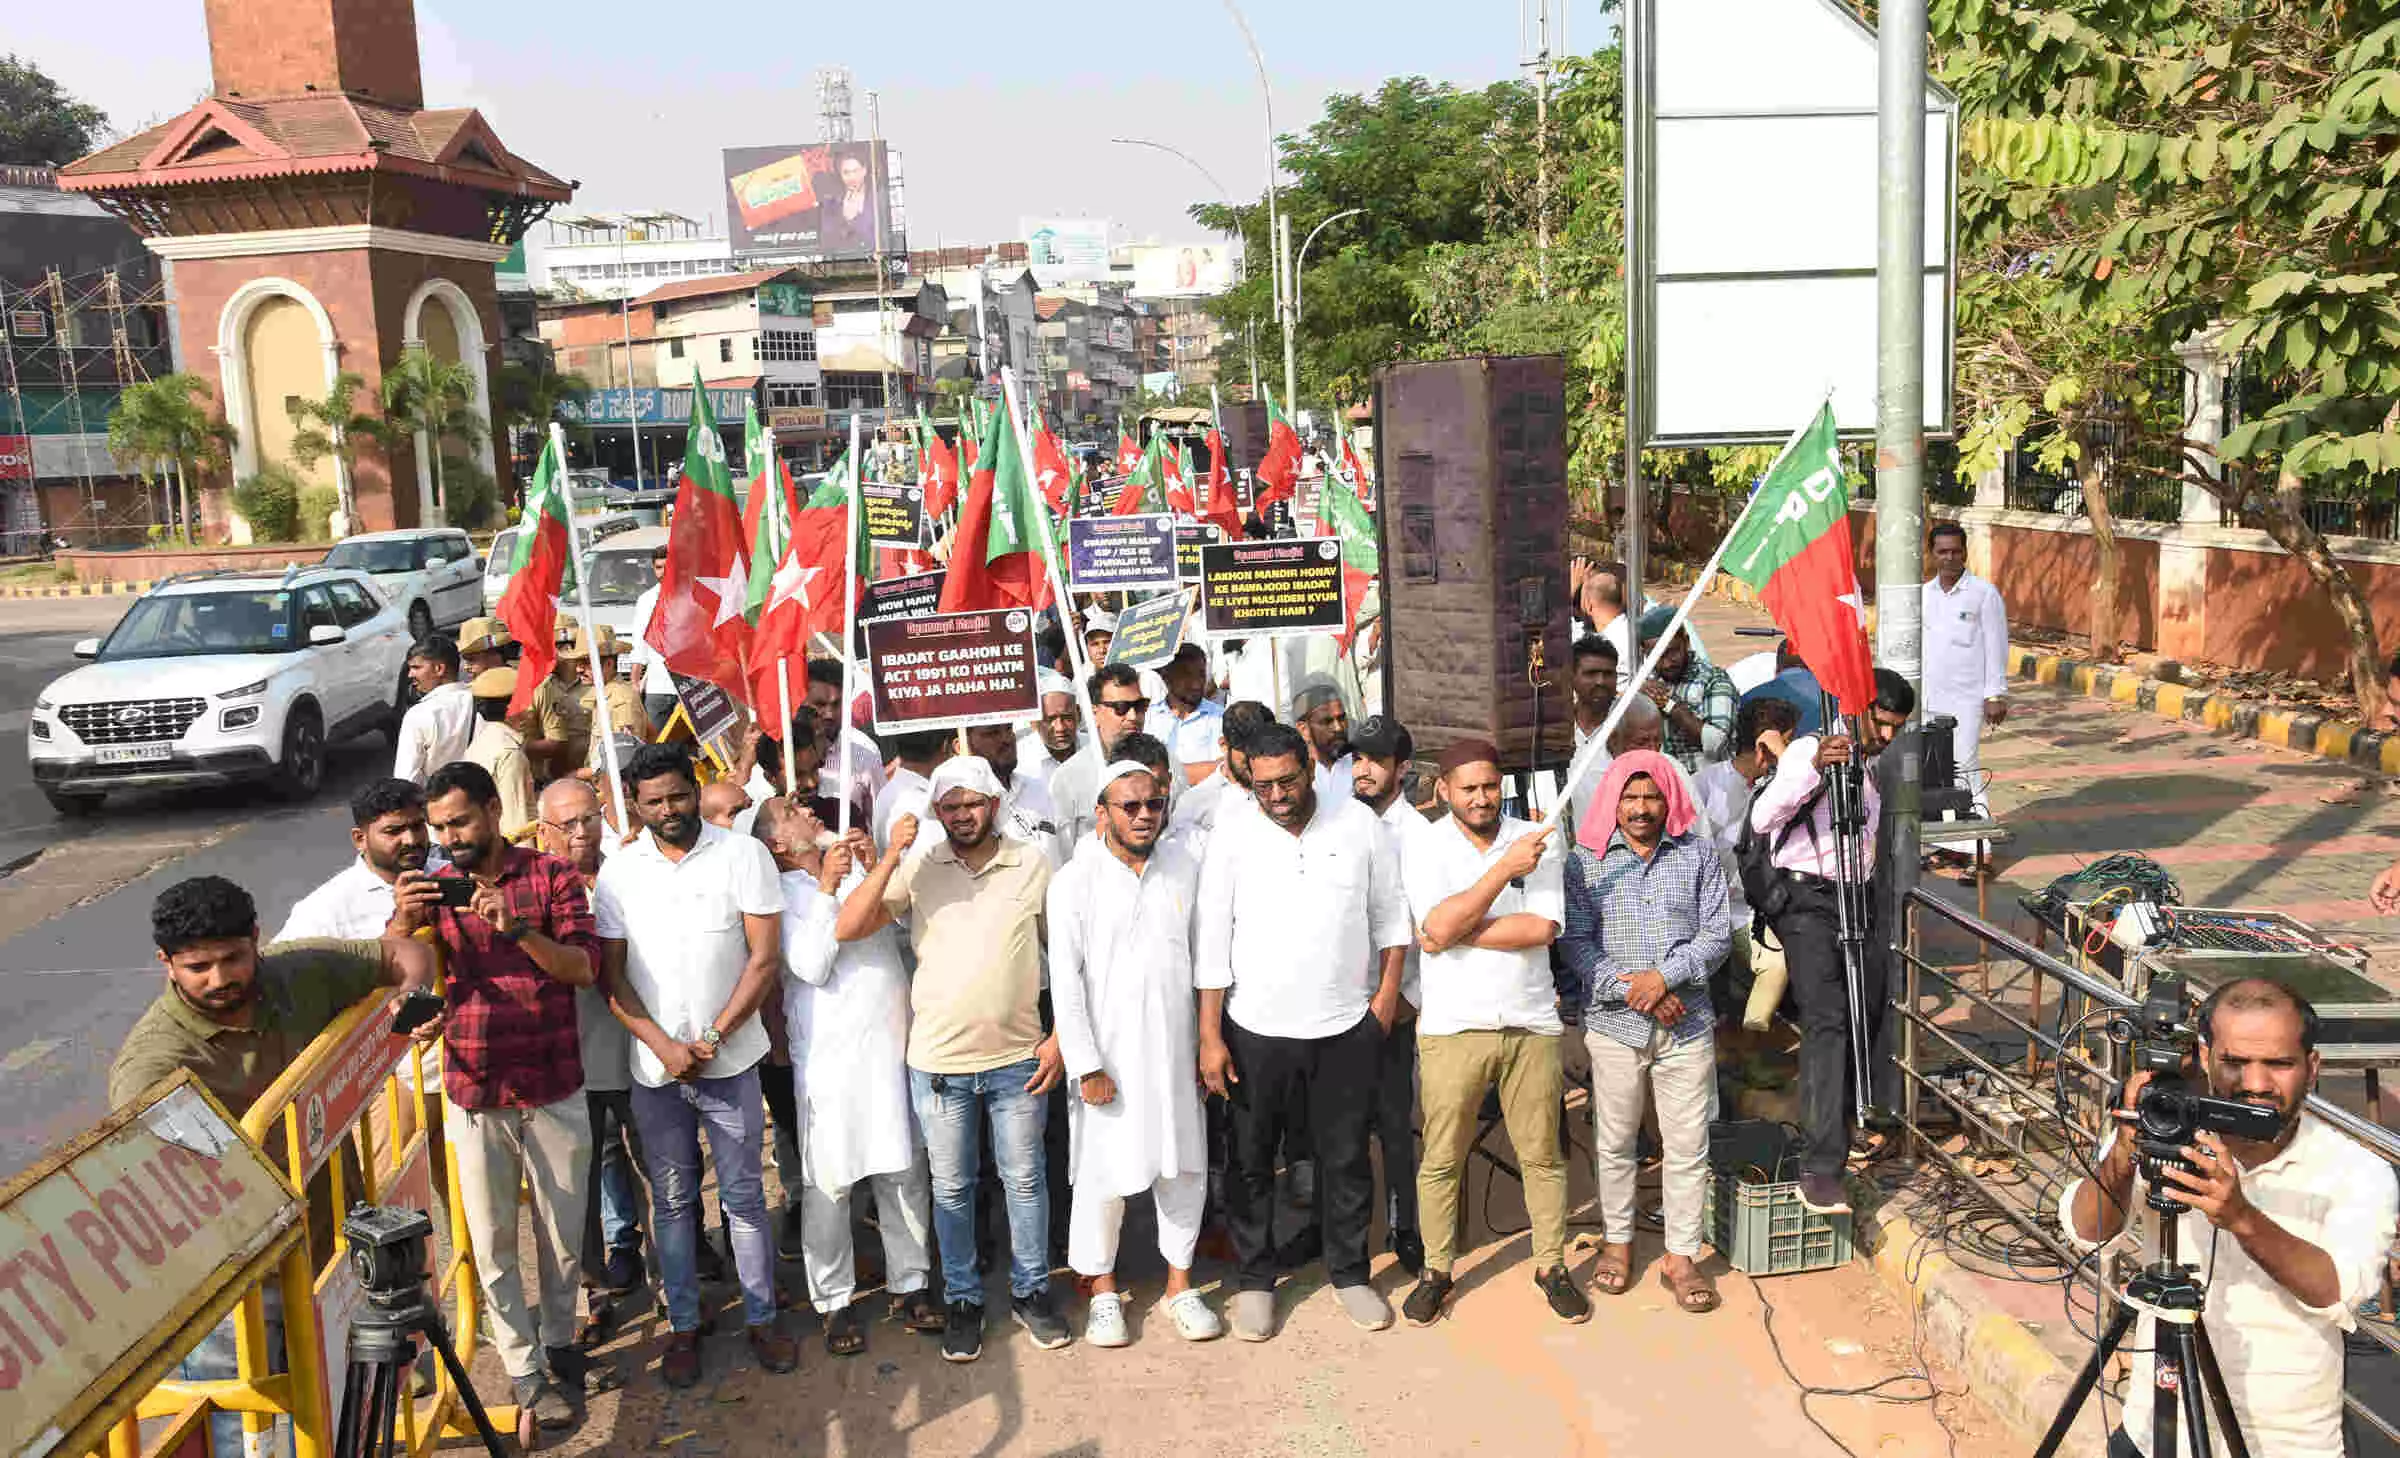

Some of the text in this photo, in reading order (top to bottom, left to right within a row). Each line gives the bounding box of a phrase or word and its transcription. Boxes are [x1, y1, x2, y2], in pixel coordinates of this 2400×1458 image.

[663, 391, 721, 418] BOMY
[1208, 567, 1337, 582] LAKHON MANDIR HONAY
[1214, 584, 1229, 593] KE
[1292, 580, 1332, 590] IBADAT
[878, 594, 937, 612] HOW MANY
[1209, 597, 1224, 607] KE
[1308, 605, 1315, 615] ?
[911, 606, 936, 617] WILL
[881, 643, 1024, 667] IBADAT GAAHON KE
[884, 660, 1025, 683] ACT 1991 KO KHATM
[887, 686, 922, 700] KIYA
[925, 683, 943, 697] JA
[945, 680, 987, 695] RAHA
[989, 678, 1015, 691] HAI
